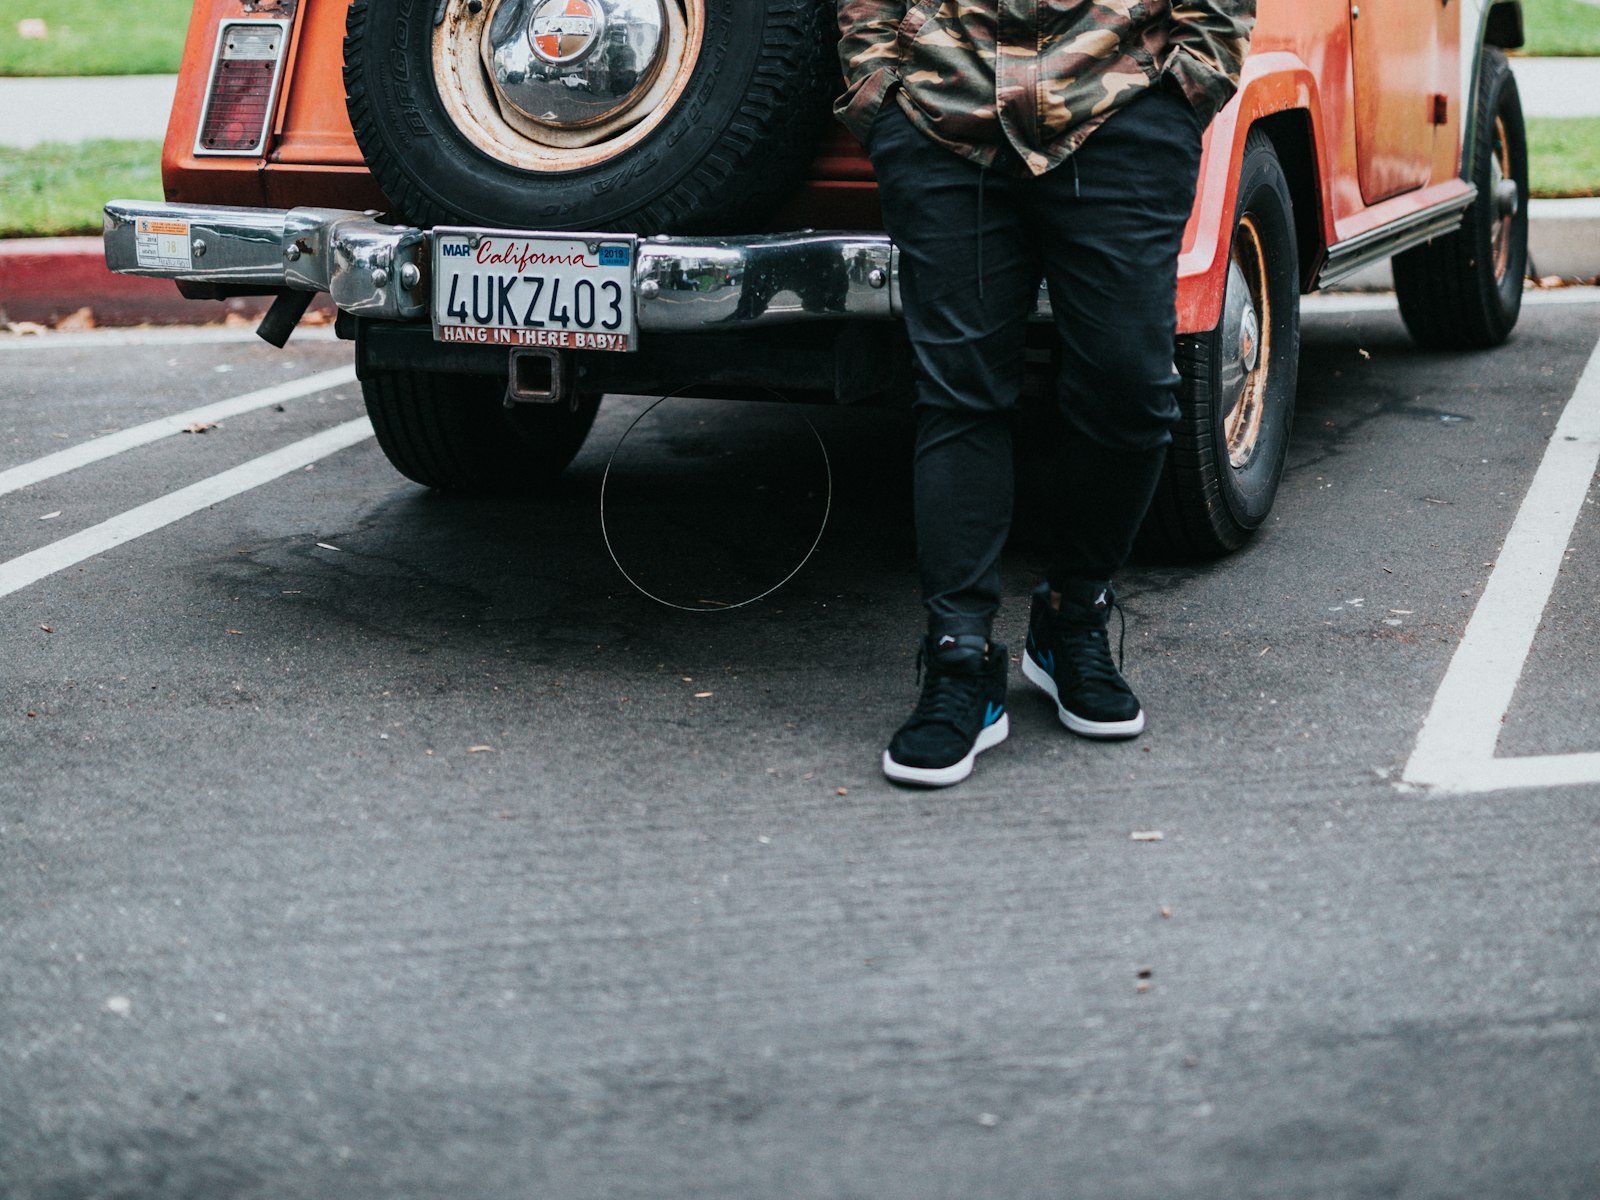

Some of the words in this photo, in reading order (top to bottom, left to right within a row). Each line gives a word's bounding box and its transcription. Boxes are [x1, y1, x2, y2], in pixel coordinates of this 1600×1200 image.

[442, 244, 471, 257] MAR
[475, 240, 599, 273] California
[604, 249, 624, 259] 2019
[447, 274, 622, 330] 4UKZ403
[443, 326, 488, 342] HANG
[493, 329, 511, 343] IN
[515, 329, 570, 347] THERE
[575, 334, 624, 349] BABY!
